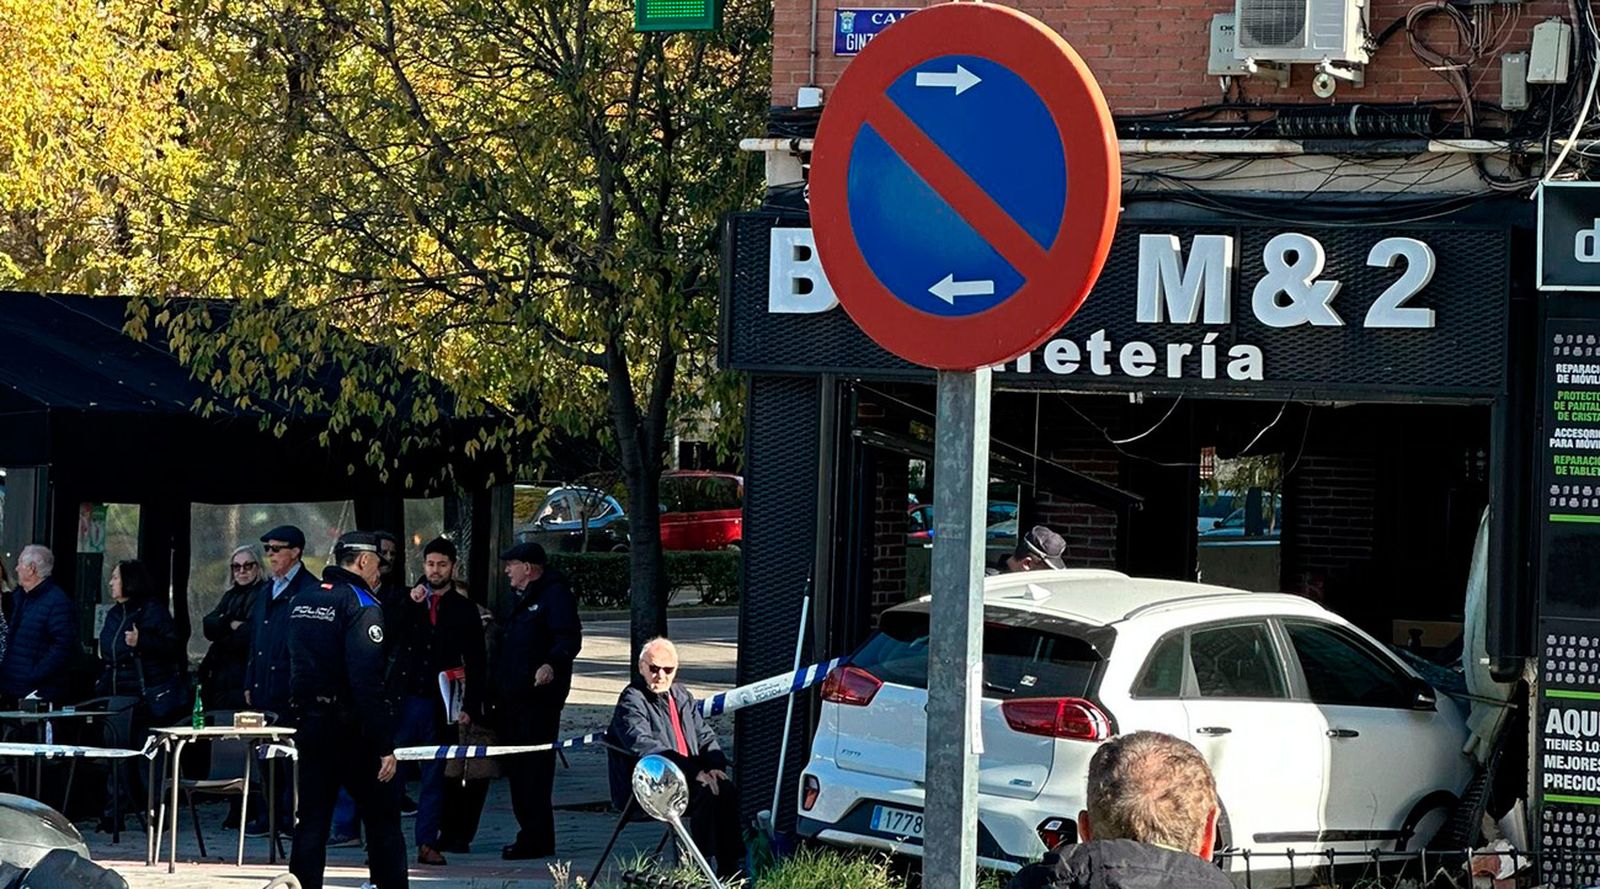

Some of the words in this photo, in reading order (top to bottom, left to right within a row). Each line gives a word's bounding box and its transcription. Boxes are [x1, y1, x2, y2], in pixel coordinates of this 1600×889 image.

[1575, 218, 1600, 262] d
[1556, 364, 1600, 374] REPARACI
[1557, 374, 1569, 383] DE
[1571, 371, 1600, 384] MÓVIL
[1557, 391, 1600, 401] PROTECTO
[1554, 401, 1566, 410] DE
[1568, 402, 1600, 411] PANTAL
[1558, 411, 1570, 420] DE
[1554, 428, 1600, 438] ACCESORI
[1550, 438, 1573, 448] PARA
[1555, 466, 1568, 475] DE
[1544, 738, 1583, 752] TIENES
[1585, 741, 1600, 753] LO
[886, 811, 923, 833] 1778
